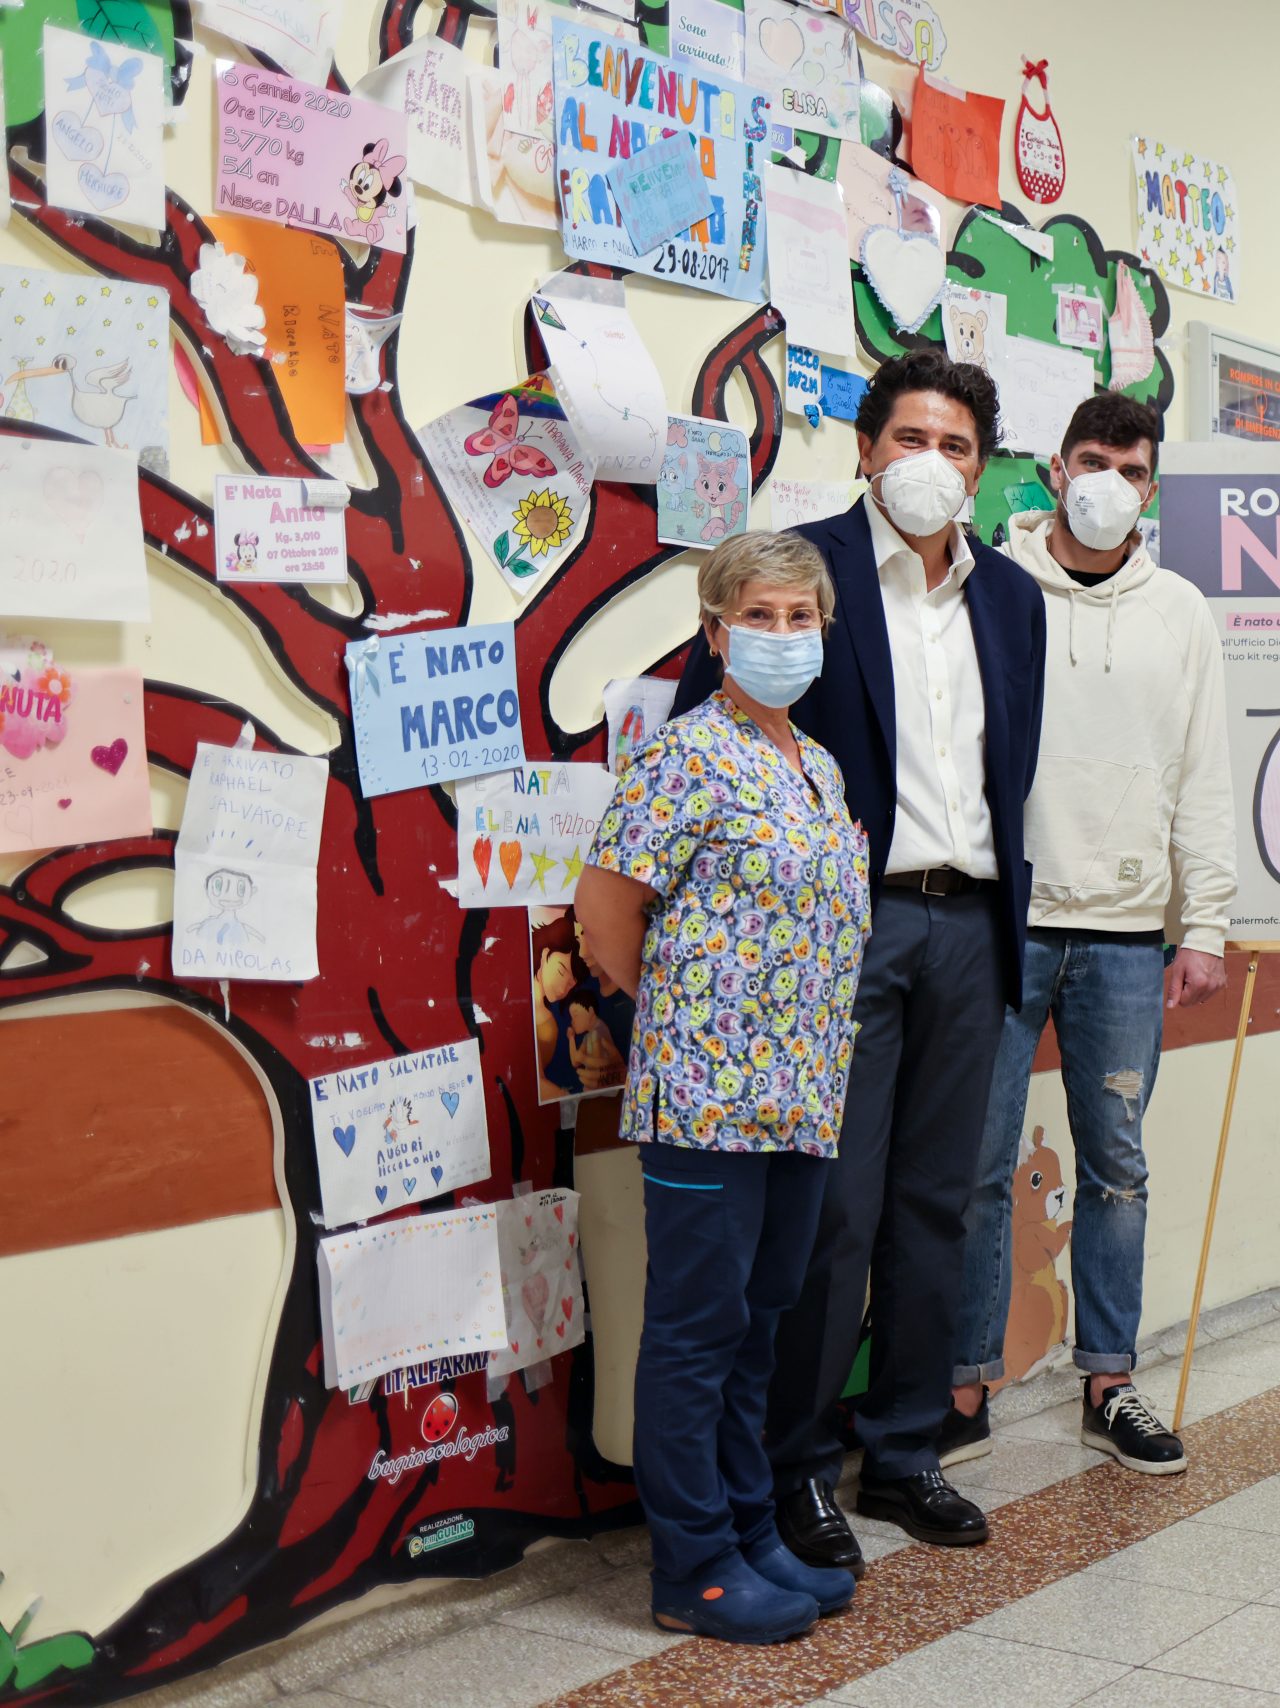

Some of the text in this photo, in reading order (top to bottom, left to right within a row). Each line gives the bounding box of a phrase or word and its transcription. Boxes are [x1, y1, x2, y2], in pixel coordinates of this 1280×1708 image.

[678, 15, 707, 38] Sono
[678, 41, 737, 71] arrivato!!
[222, 63, 351, 118] 6 Gennaio 2020
[557, 33, 737, 142] BENVENUTO
[224, 97, 255, 120] Ore
[782, 88, 828, 118] ELISA
[56, 118, 94, 153] ANGELO
[560, 96, 598, 153] AL
[224, 127, 304, 165] 3.770 kg
[223, 156, 279, 186] 54 cm
[221, 183, 342, 231] Nasce DALILA
[1145, 170, 1226, 235] MATTEO
[1229, 368, 1263, 387] ROMPERE
[1265, 376, 1273, 390] IN
[1235, 419, 1244, 430] DI
[541, 418, 575, 463] MARIANNA
[224, 485, 282, 500] E' Nata
[270, 501, 325, 524] Anna
[267, 546, 339, 560] 07 Ottobre 2019
[275, 532, 293, 544] Kg.
[13, 557, 77, 584] 2020
[285, 564, 300, 572] ore
[1233, 615, 1242, 627] È
[1244, 617, 1273, 627] nato
[425, 640, 505, 679] NATO
[1227, 653, 1245, 661] tuo
[1247, 652, 1260, 661] kit
[400, 689, 520, 752] MARCO
[223, 755, 294, 780] ARRIVATO
[513, 766, 571, 796] NATA
[209, 795, 311, 840] SALVATORE
[475, 806, 541, 837] ELENA
[182, 948, 207, 966] DA
[336, 1067, 379, 1095] NATO
[389, 1046, 459, 1079] SALVATORE
[368, 1423, 509, 1485] buginecologica
[419, 1513, 464, 1533] REALIZZAZIONE
[436, 1519, 475, 1541] GULINO
